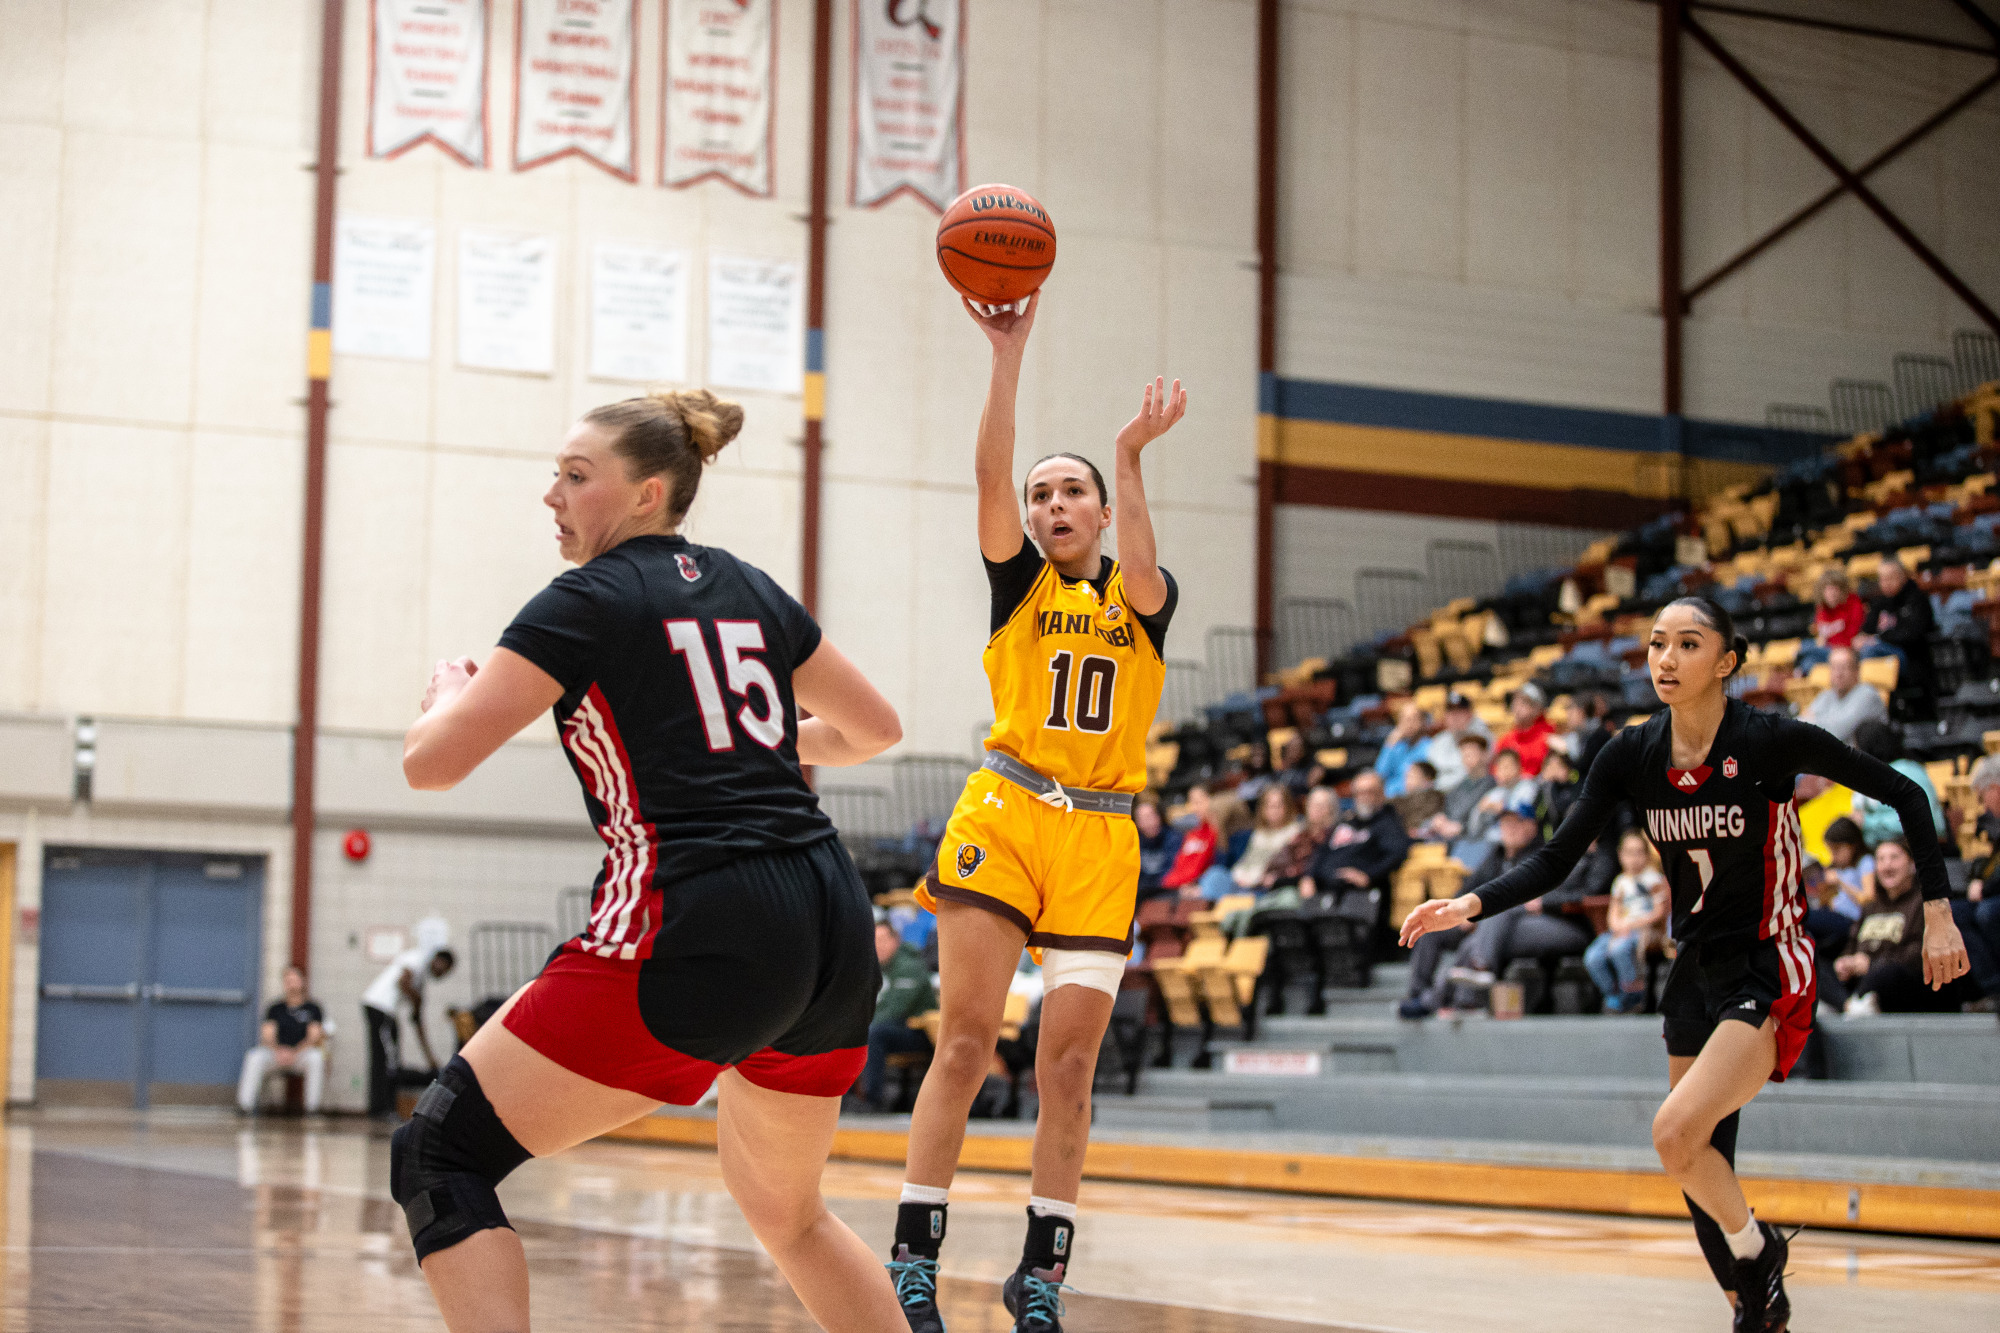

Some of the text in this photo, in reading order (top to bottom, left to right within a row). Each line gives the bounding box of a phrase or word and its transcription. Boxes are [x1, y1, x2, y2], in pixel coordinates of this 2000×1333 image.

[969, 194, 1046, 223] Wilson
[662, 618, 785, 753] 15
[1043, 649, 1118, 735] 10
[1646, 805, 1745, 842] WINNIPEG
